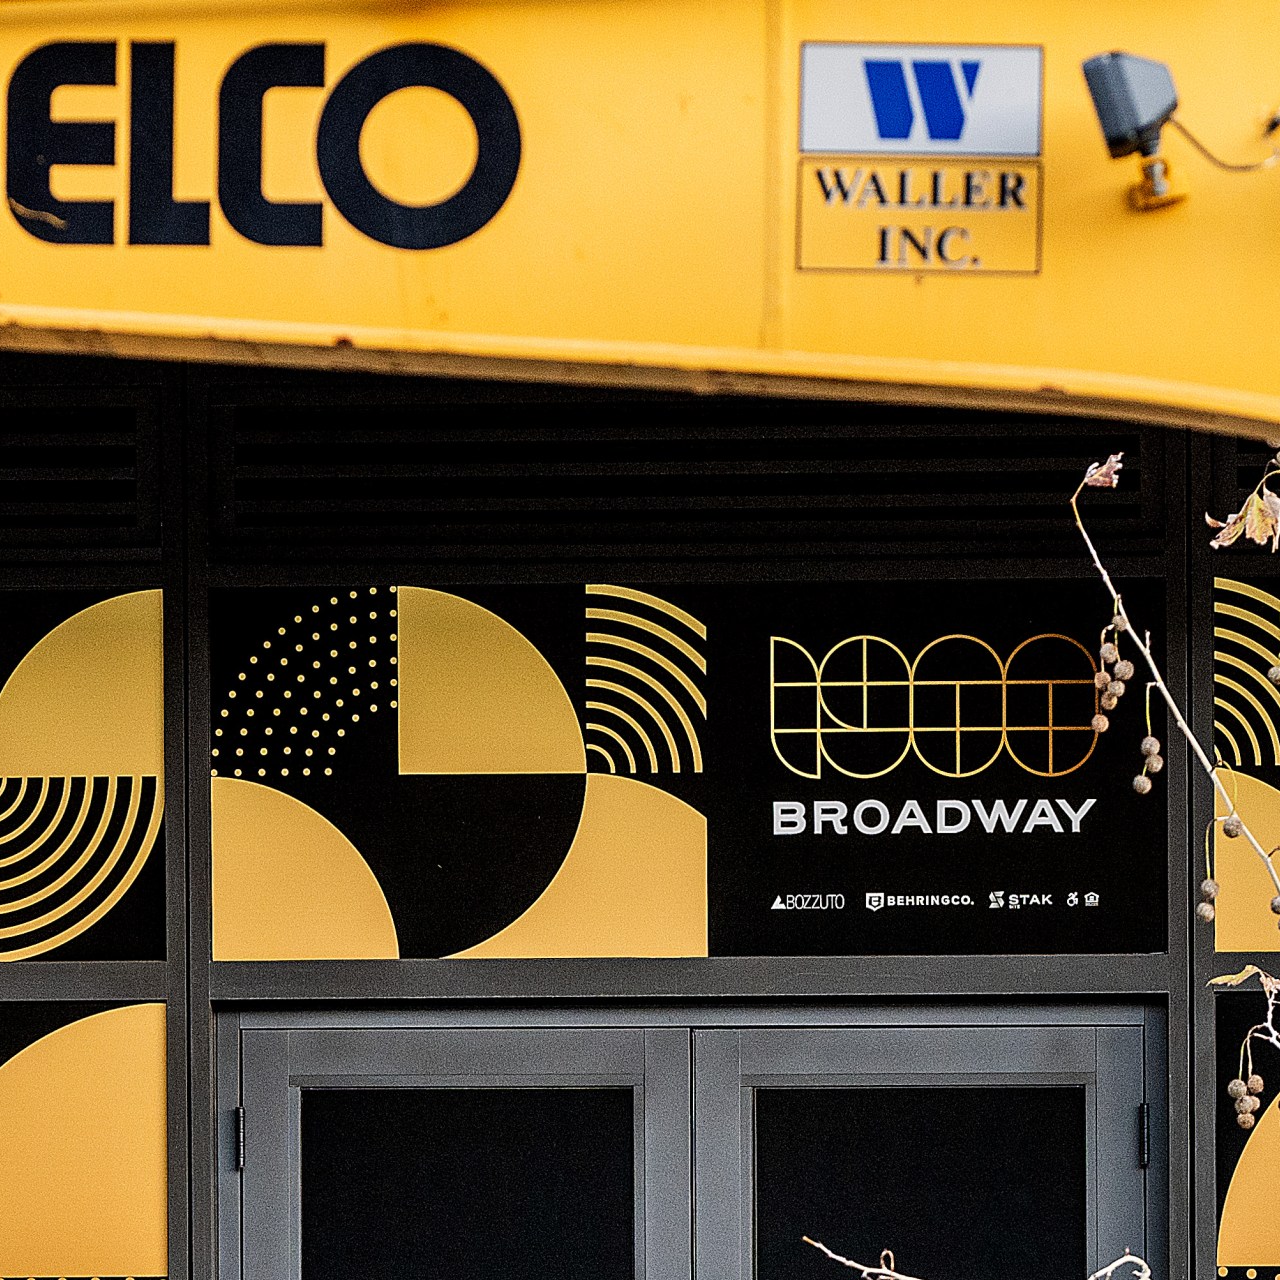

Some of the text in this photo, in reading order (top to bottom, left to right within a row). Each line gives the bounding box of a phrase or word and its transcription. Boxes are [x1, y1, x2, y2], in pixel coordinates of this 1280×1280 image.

[815, 167, 1028, 211] WALLER
[877, 225, 983, 269] INC.
[772, 798, 1097, 836] BROADWAY
[786, 893, 845, 910] BOZZUTO
[1008, 892, 1053, 906] STAK
